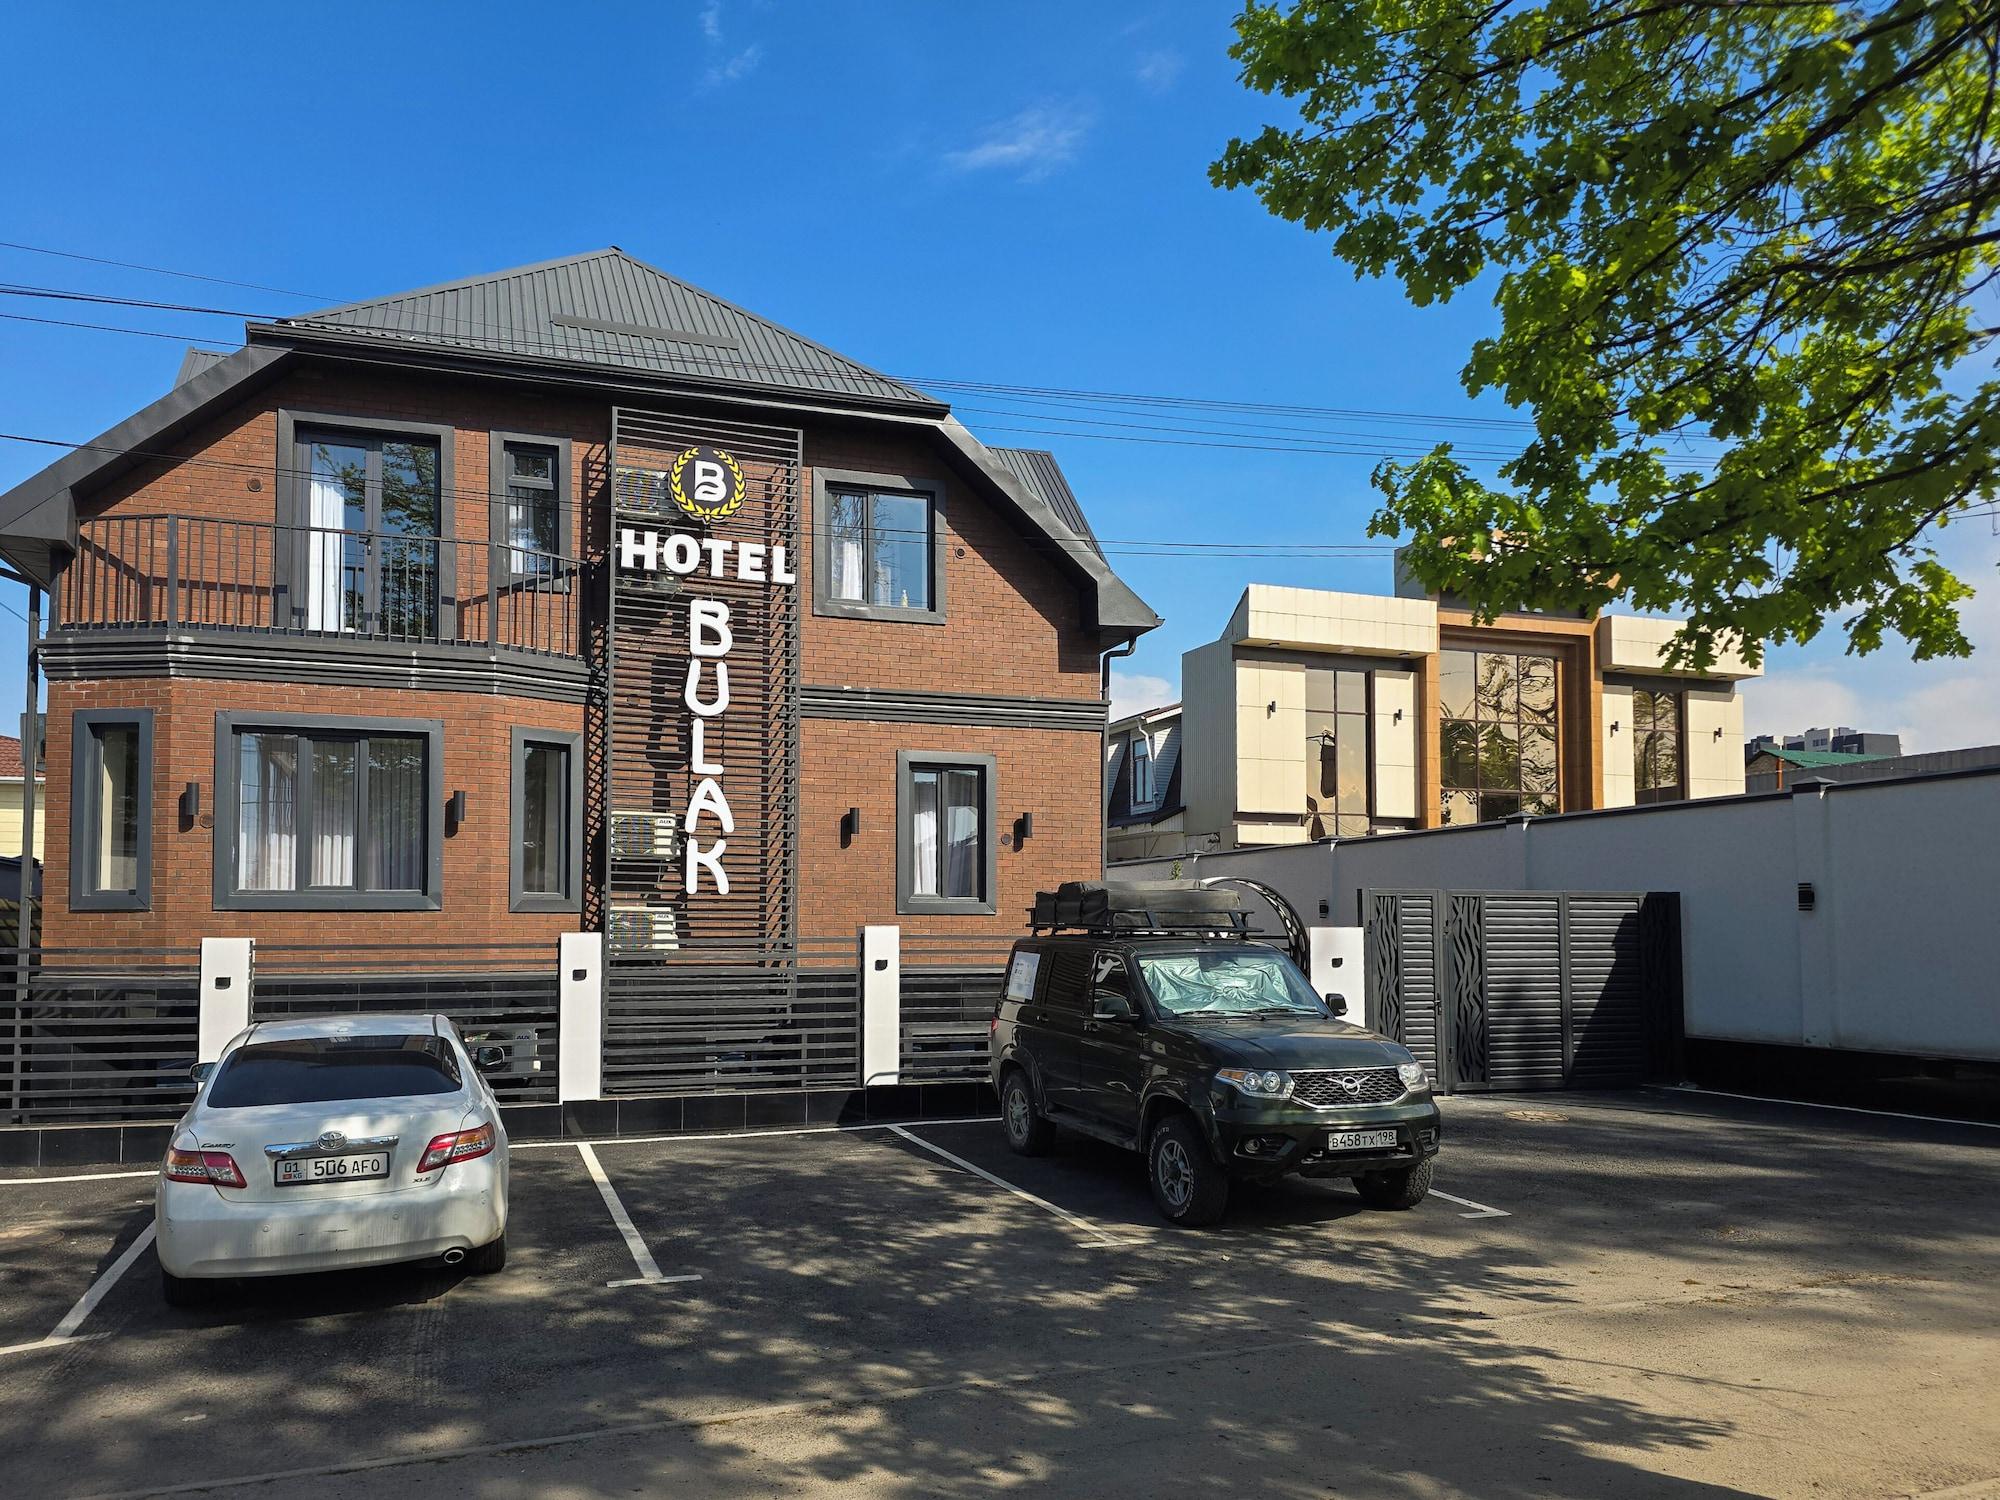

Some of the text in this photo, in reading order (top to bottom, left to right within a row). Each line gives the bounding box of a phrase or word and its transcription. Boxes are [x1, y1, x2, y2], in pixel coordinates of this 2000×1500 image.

[620, 528, 796, 584] HOTEL
[684, 599, 735, 895] BULAK
[284, 1162, 300, 1173] 01
[314, 1159, 347, 1177] 506
